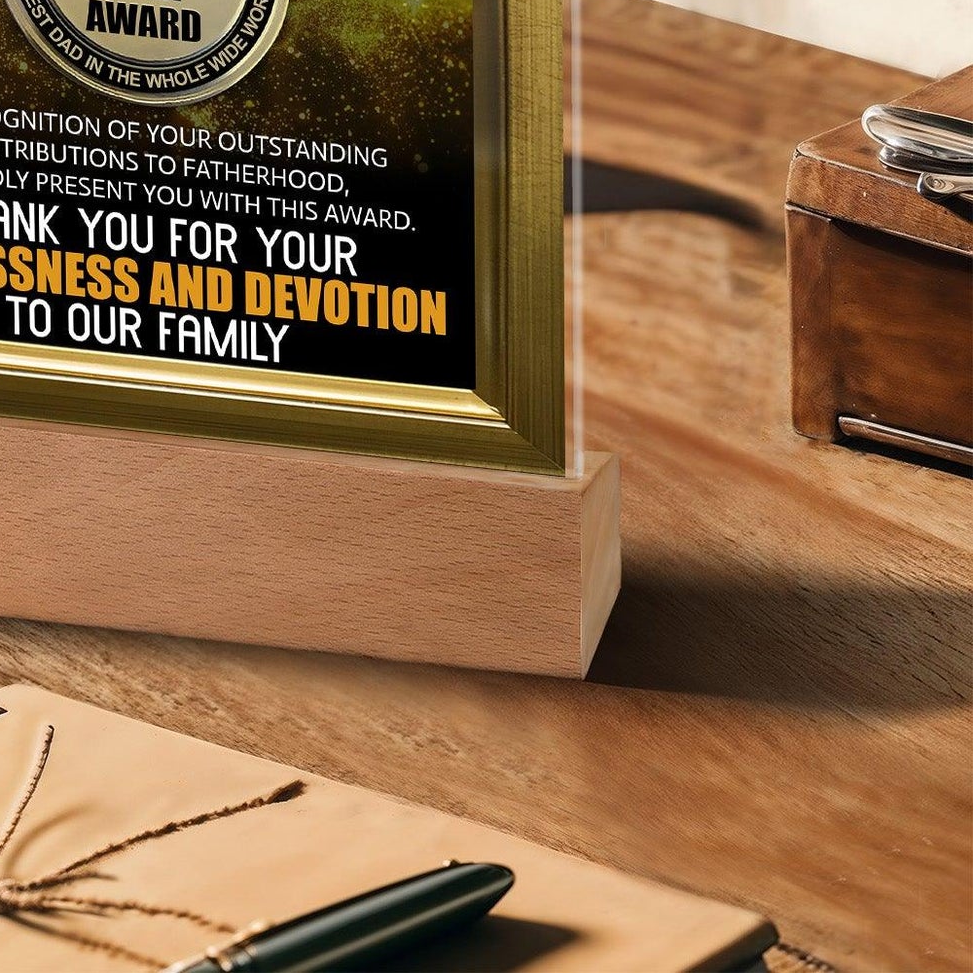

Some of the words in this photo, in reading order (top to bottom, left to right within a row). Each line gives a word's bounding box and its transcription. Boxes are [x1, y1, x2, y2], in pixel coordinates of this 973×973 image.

[86, 0, 201, 42] AWARD
[49, 27, 83, 61] DAD
[85, 53, 104, 74] IN
[108, 68, 140, 87] THE
[145, 62, 209, 89] WHOLE
[209, 38, 248, 71] WIDE
[108, 119, 140, 141] OF
[146, 123, 212, 150] YOUR
[218, 132, 388, 168] OUTSTANDING
[36, 173, 138, 202] PRESENT
[143, 184, 193, 207] YOU
[200, 189, 261, 215] WITH
[266, 196, 318, 221] THIS
[324, 204, 416, 232] AWARD.
[144, 154, 176, 175] TO
[183, 158, 349, 197] FATHERHOOD,
[77, 207, 154, 254] YOU
[170, 218, 238, 264] FOR
[255, 227, 358, 277] YOUR
[149, 261, 233, 312] AND
[245, 270, 447, 336] DEVOTION
[5, 295, 51, 338] TO
[68, 302, 143, 349] OUR
[158, 311, 290, 363] FAMILY
